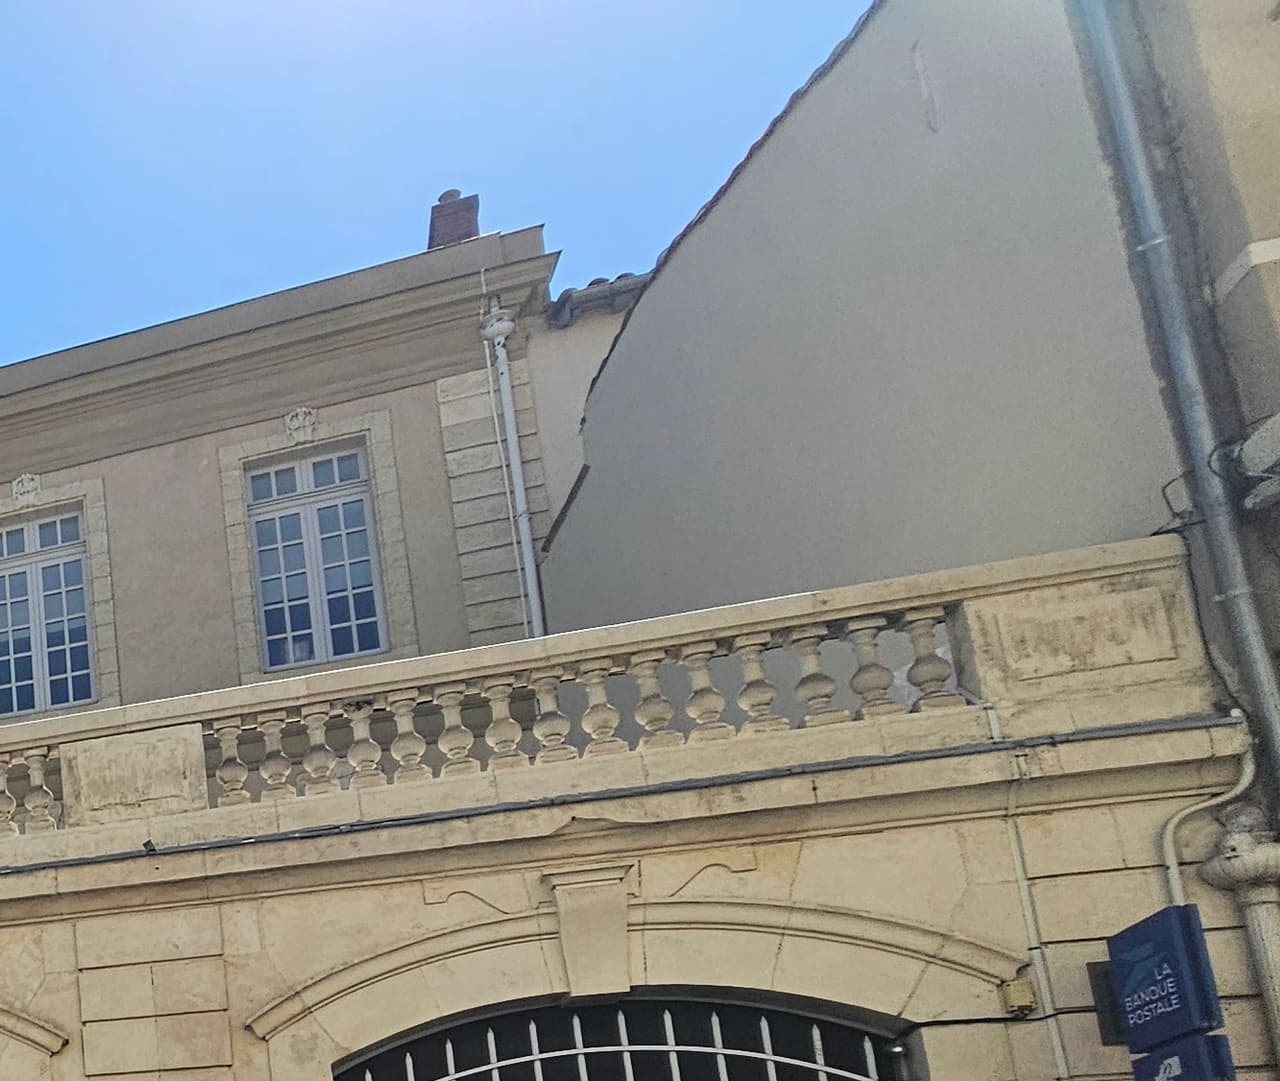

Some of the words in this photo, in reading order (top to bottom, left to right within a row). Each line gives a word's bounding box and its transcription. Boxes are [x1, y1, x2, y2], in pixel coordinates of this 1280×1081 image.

[1154, 962, 1173, 980] LA
[1124, 978, 1177, 1011] BANQUE
[1128, 994, 1181, 1027] POSTALE
